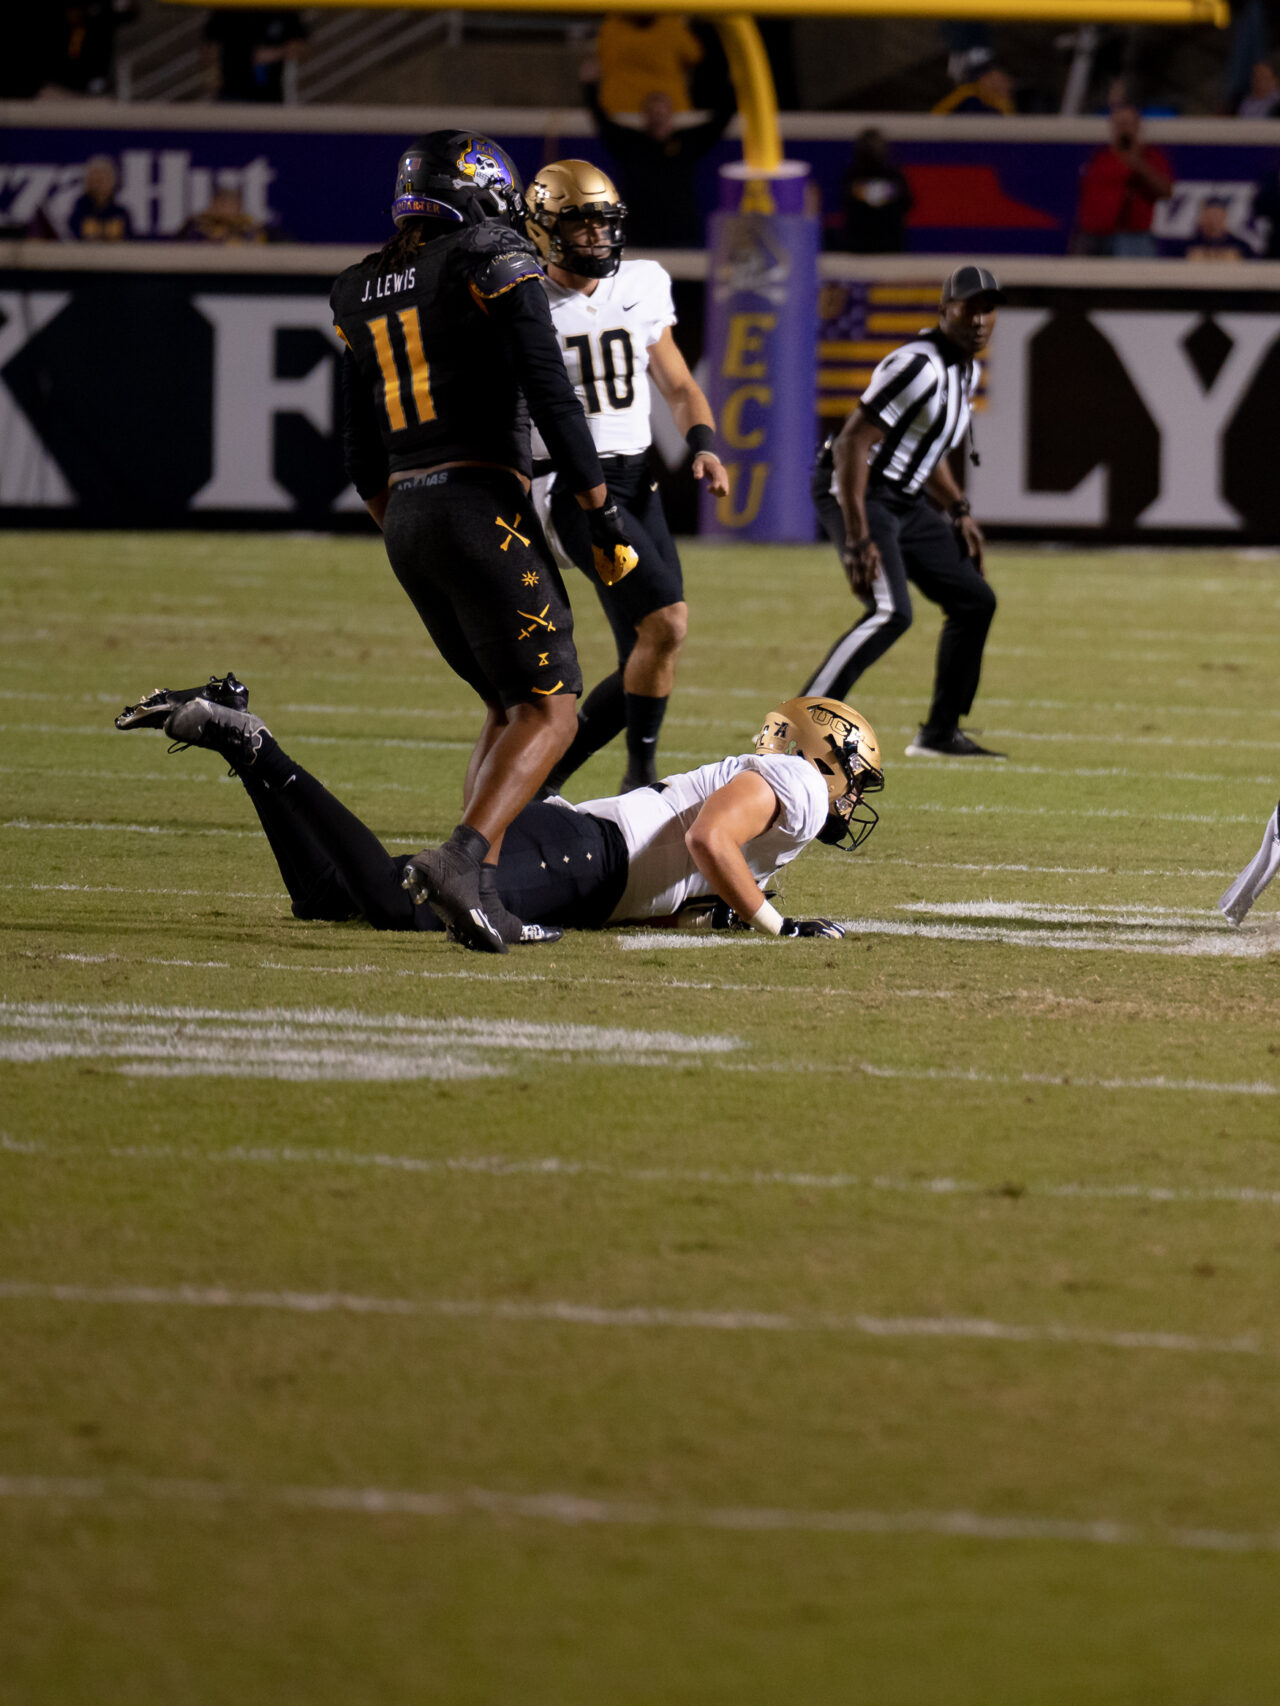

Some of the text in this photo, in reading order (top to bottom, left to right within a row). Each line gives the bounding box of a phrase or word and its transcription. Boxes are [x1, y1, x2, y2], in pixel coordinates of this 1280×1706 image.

[361, 267, 416, 303] J. LEWIS
[366, 305, 437, 433] 11
[562, 326, 636, 416] 10
[714, 313, 776, 527] ECU
